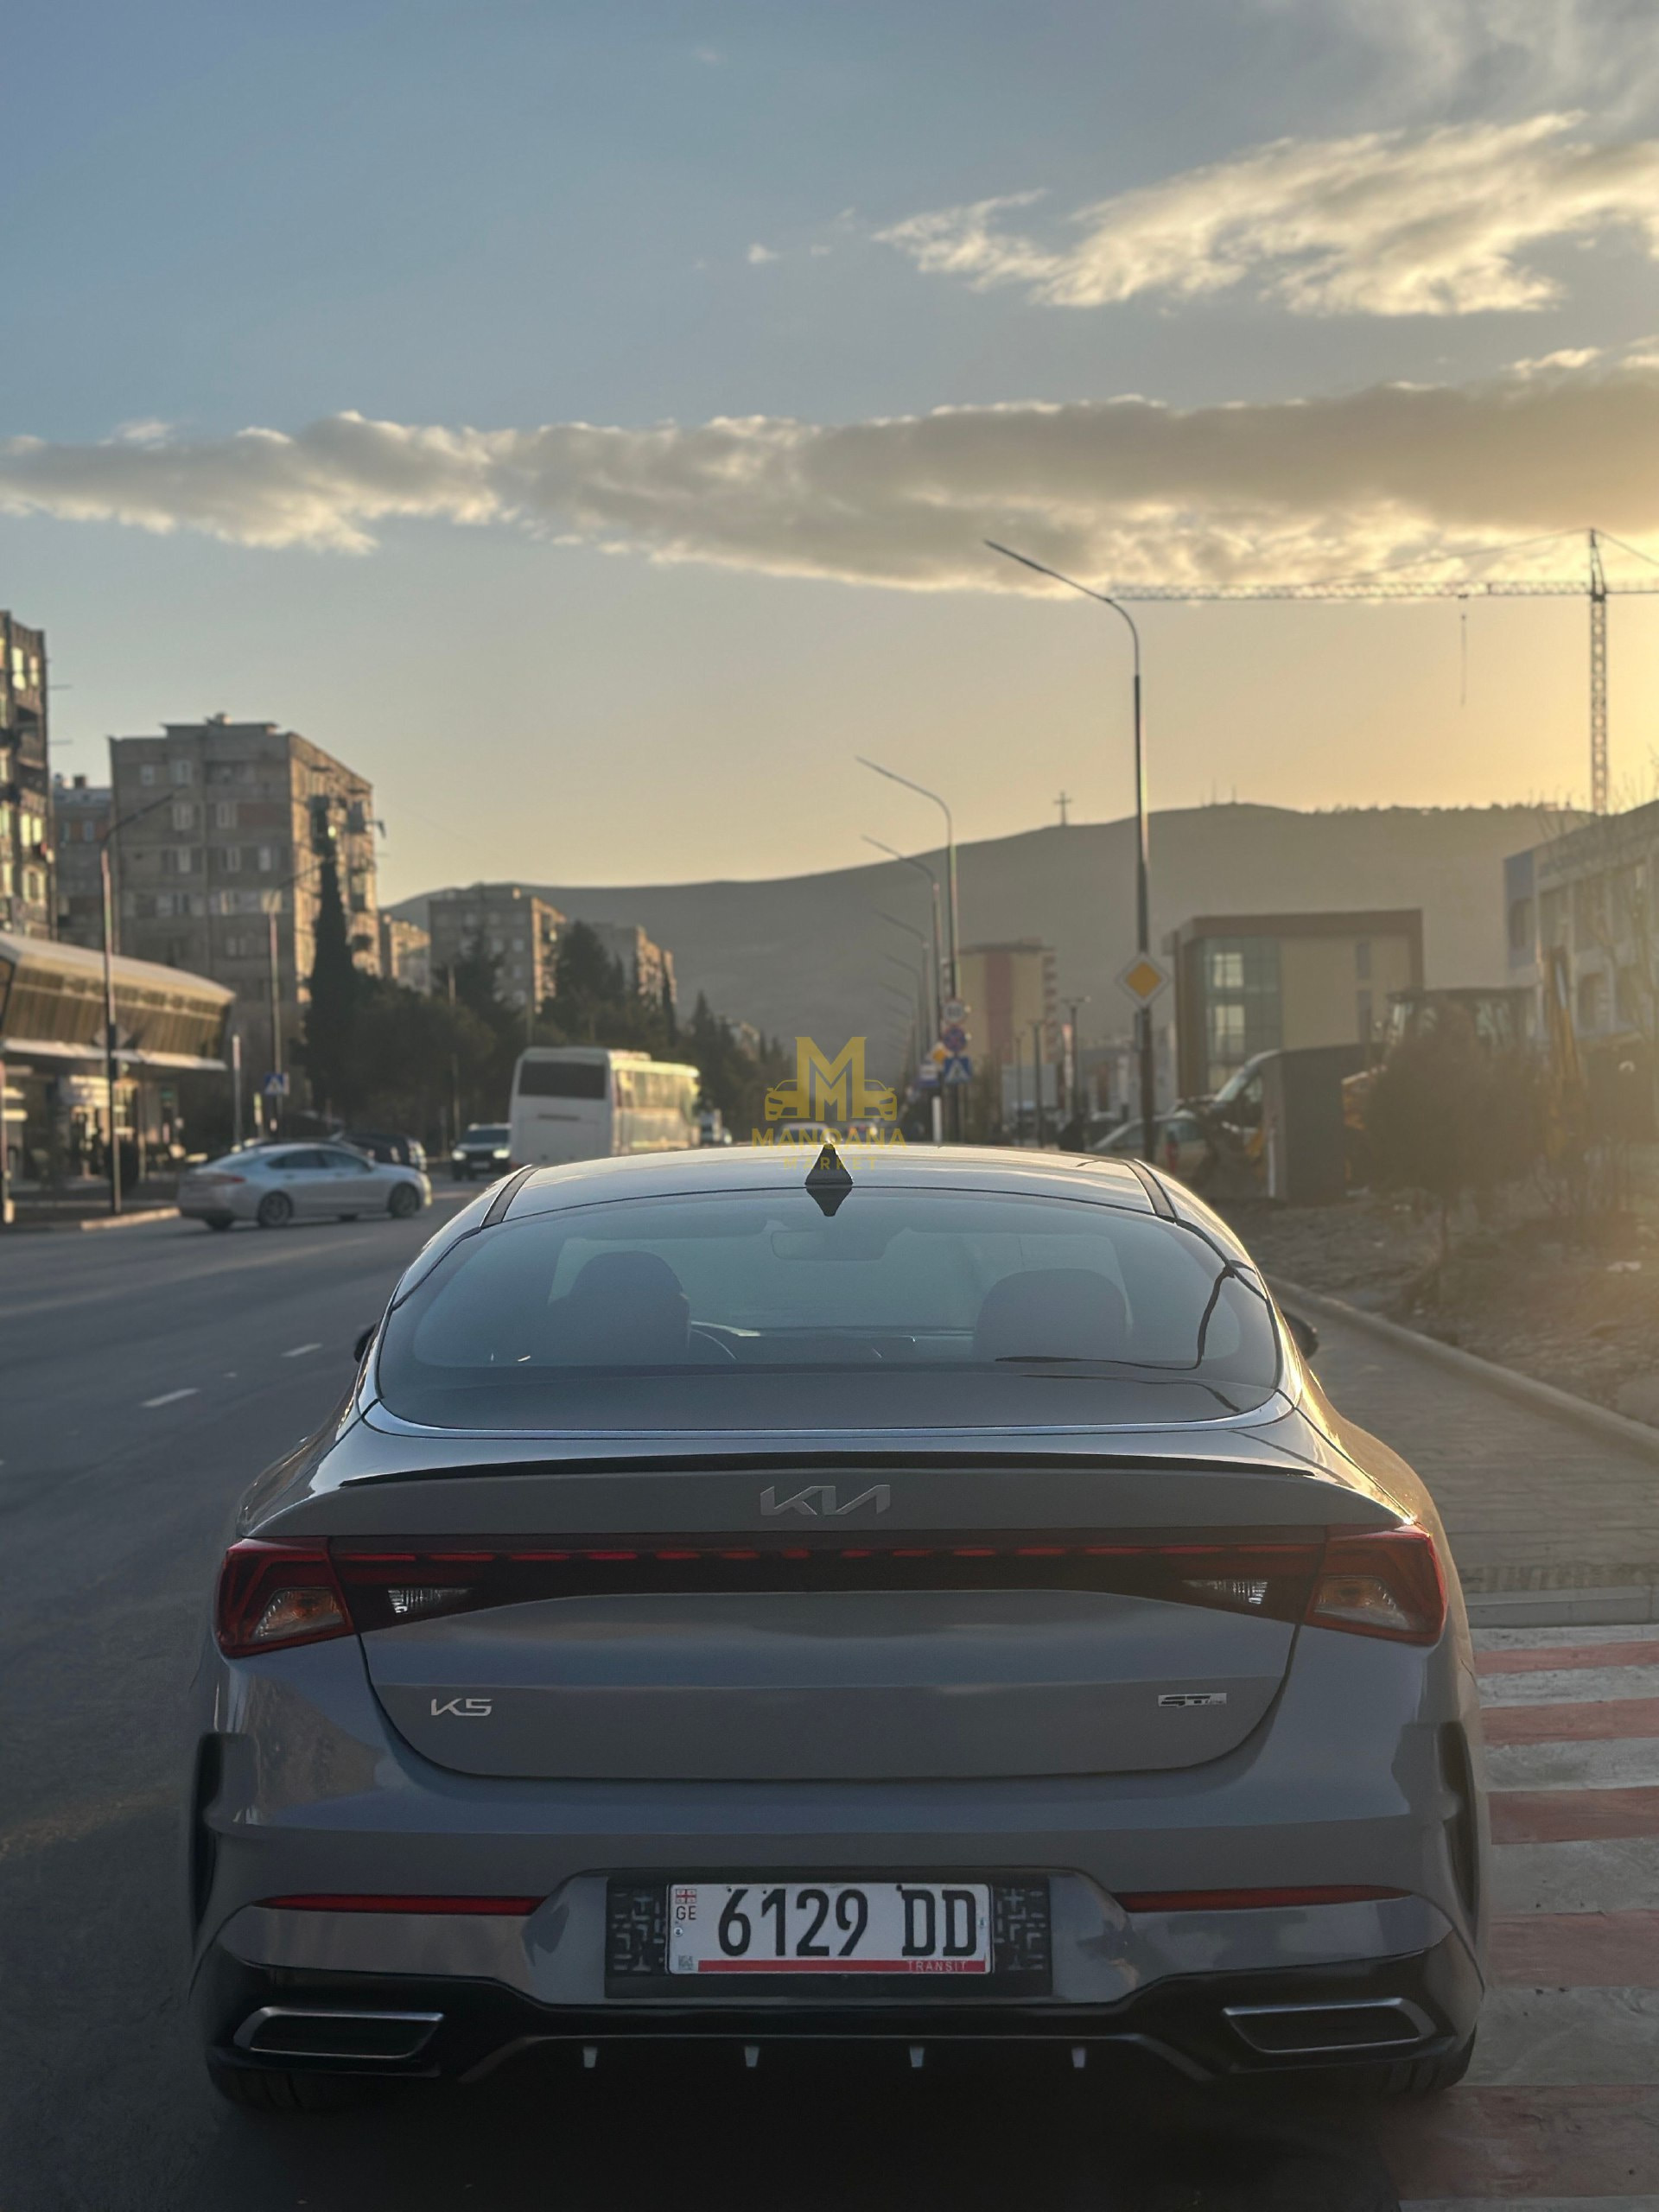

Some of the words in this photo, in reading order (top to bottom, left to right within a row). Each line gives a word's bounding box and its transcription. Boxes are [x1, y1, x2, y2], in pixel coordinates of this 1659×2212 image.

[760, 1484, 890, 1516] KIA
[431, 1699, 493, 1717] K5
[676, 1905, 696, 1920] GE
[718, 1888, 868, 1956] 6129
[901, 1890, 977, 1956] DD
[908, 1961, 967, 1973] TRANSIT
